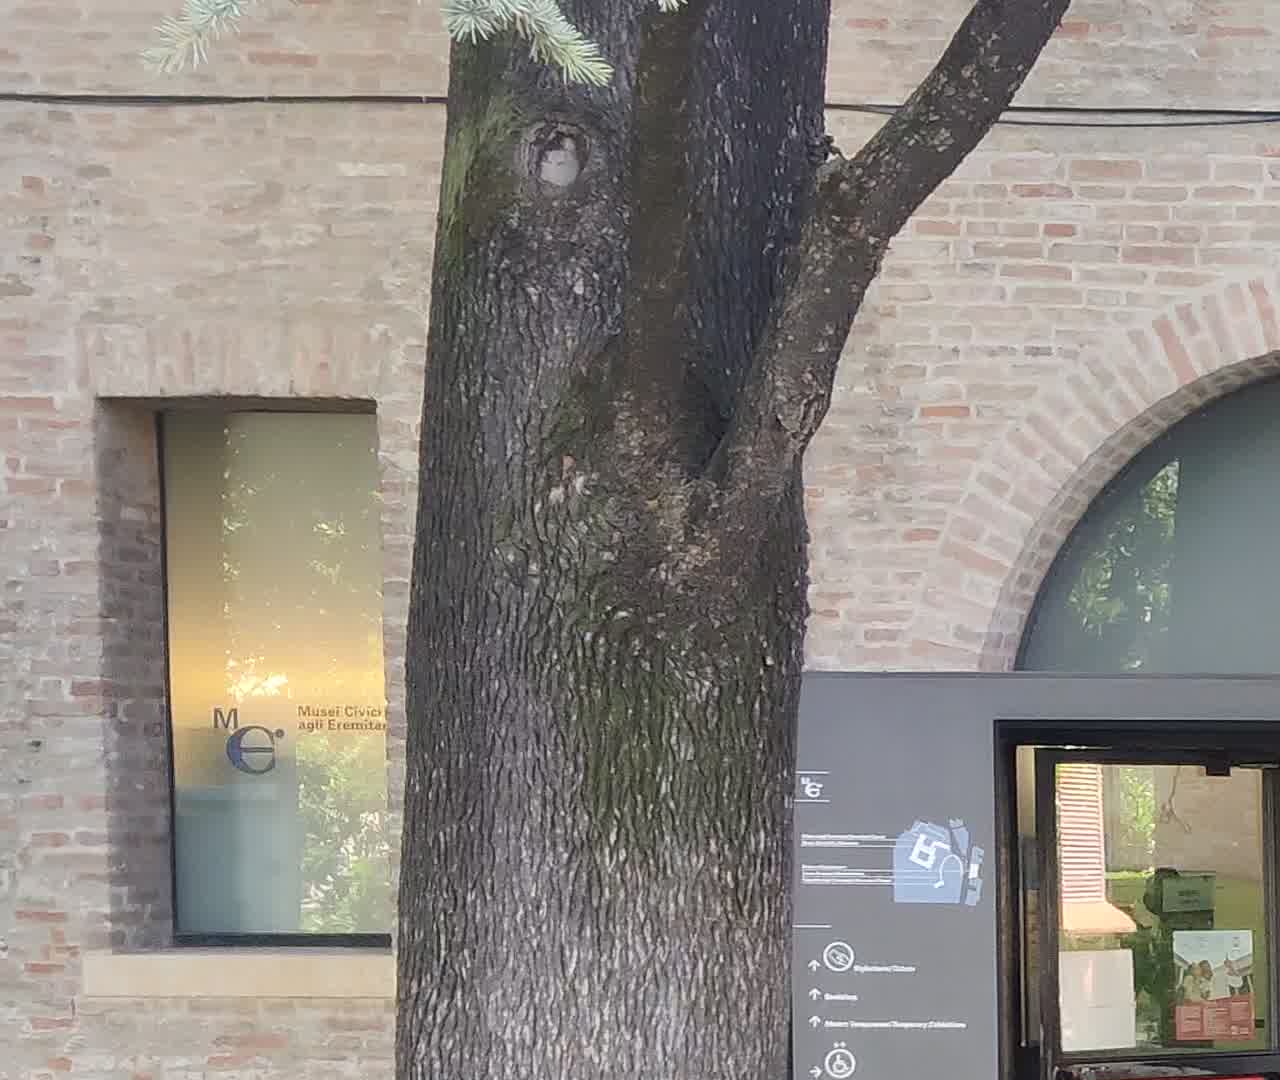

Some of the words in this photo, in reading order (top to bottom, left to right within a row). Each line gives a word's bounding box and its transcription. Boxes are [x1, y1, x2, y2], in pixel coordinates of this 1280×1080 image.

[298, 705, 340, 717] Musei
[298, 719, 324, 732] agli
[327, 719, 387, 730] Eremitan
